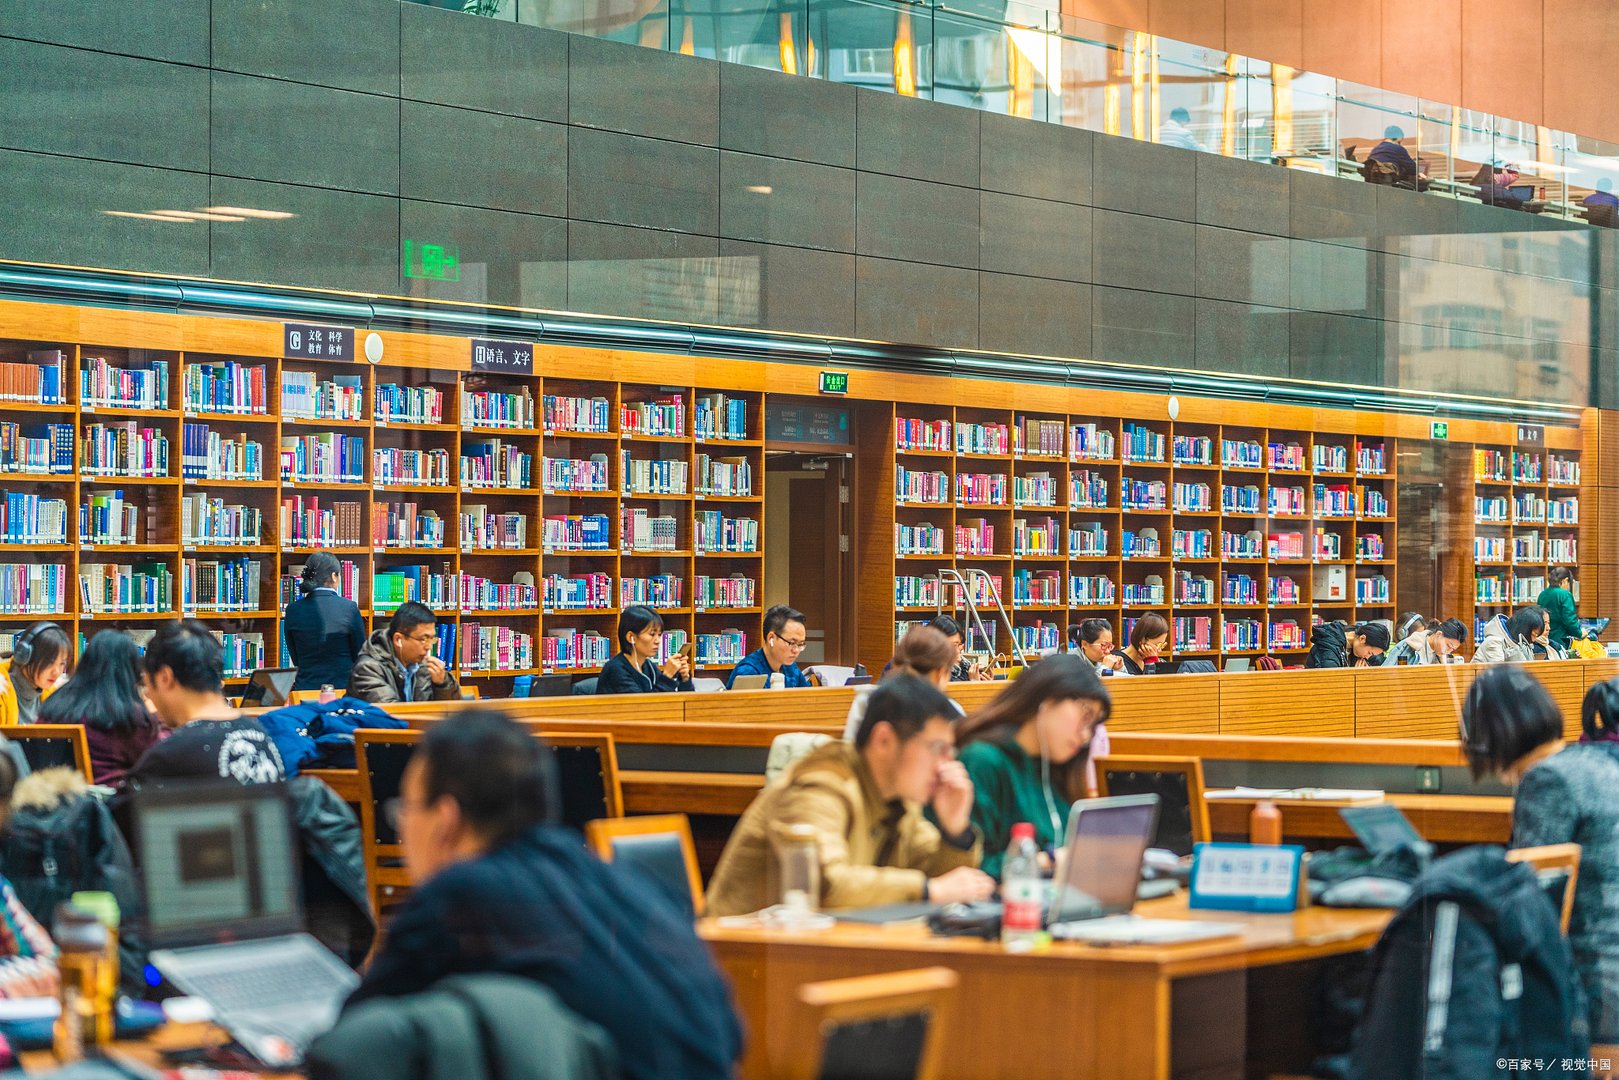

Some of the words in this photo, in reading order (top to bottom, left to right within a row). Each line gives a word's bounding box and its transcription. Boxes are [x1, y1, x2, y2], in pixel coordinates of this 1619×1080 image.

[290, 332, 300, 349] G
[308, 329, 322, 341] 文化
[328, 331, 342, 343] 科学
[307, 342, 322, 354] 教育
[328, 344, 342, 355] 体育
[476, 346, 486, 363] H
[826, 375, 845, 385] 安全出口
